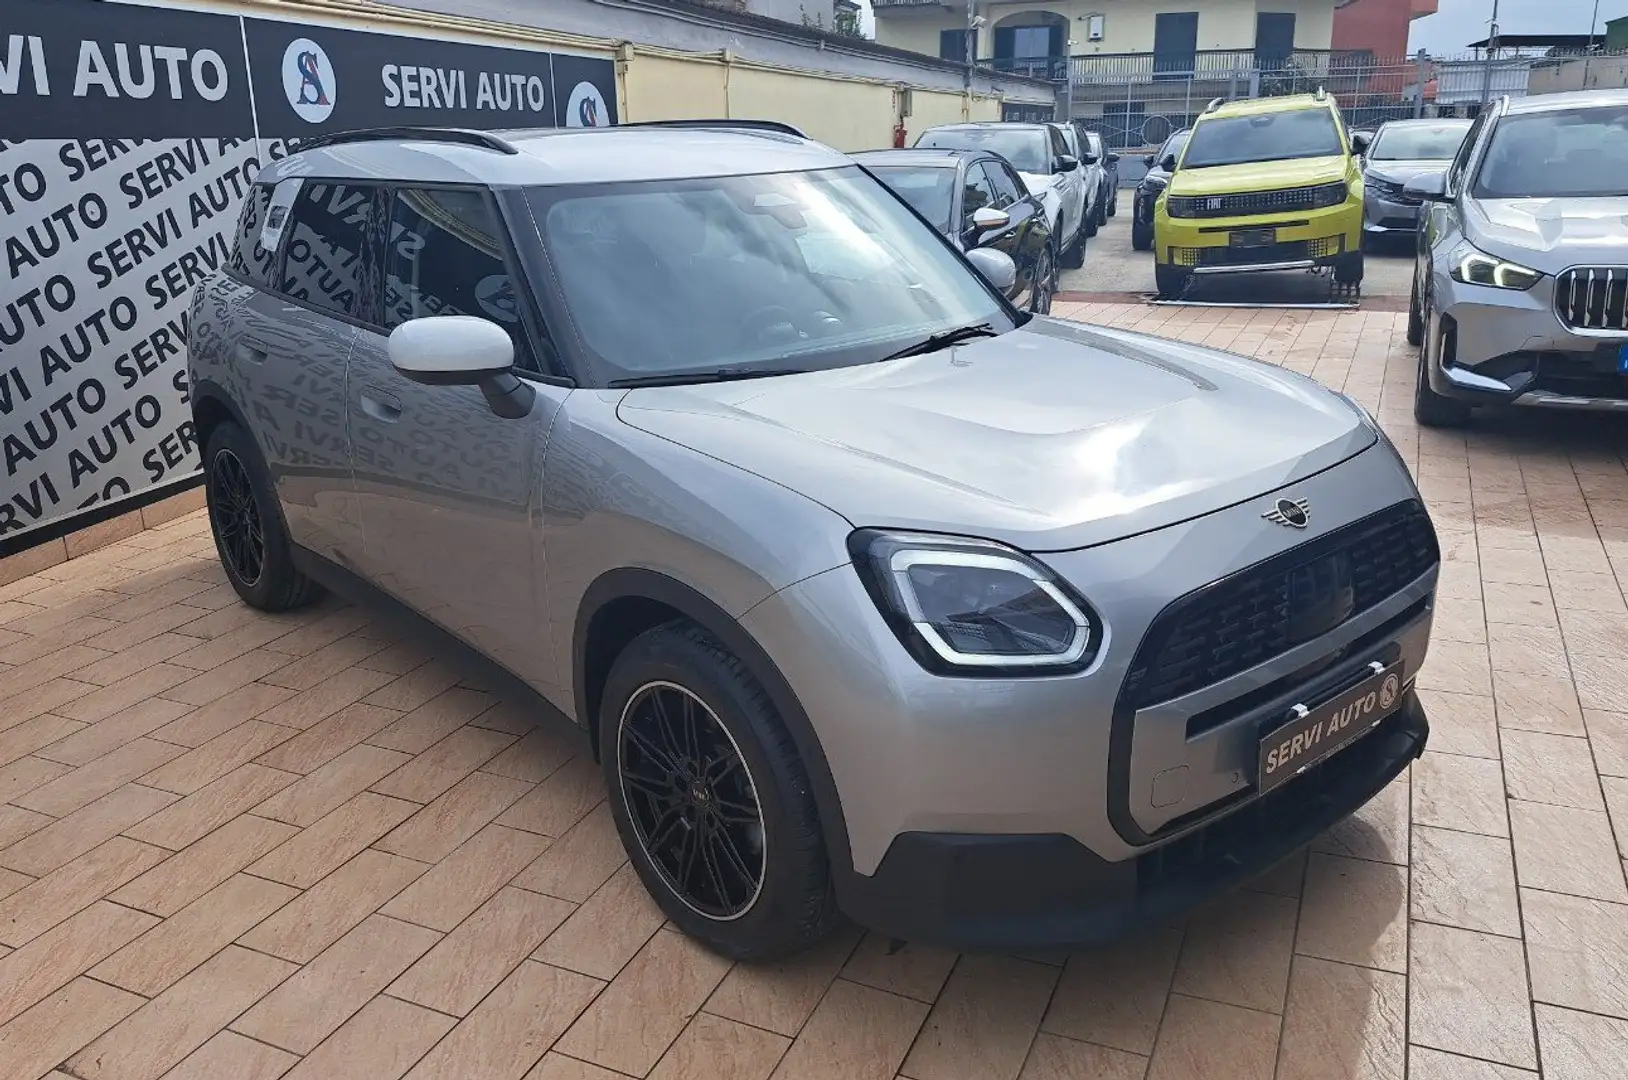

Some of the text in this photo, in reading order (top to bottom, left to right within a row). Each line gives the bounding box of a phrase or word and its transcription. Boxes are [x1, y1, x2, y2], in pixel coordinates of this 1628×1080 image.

[73, 39, 228, 101] AUTO
[381, 64, 468, 110] SERVI
[476, 71, 545, 112] AUTO
[5, 138, 210, 280] AUTO SERVI
[87, 207, 182, 290] SERVI
[188, 157, 260, 229] AUTO
[1207, 197, 1223, 210] FIAT
[40, 296, 138, 387] AUTO
[145, 231, 231, 310] SERVI
[3, 378, 106, 477] AUTO
[68, 395, 161, 489] AUTO
[1266, 721, 1324, 774] SERVI
[1326, 691, 1376, 737] AUTO
